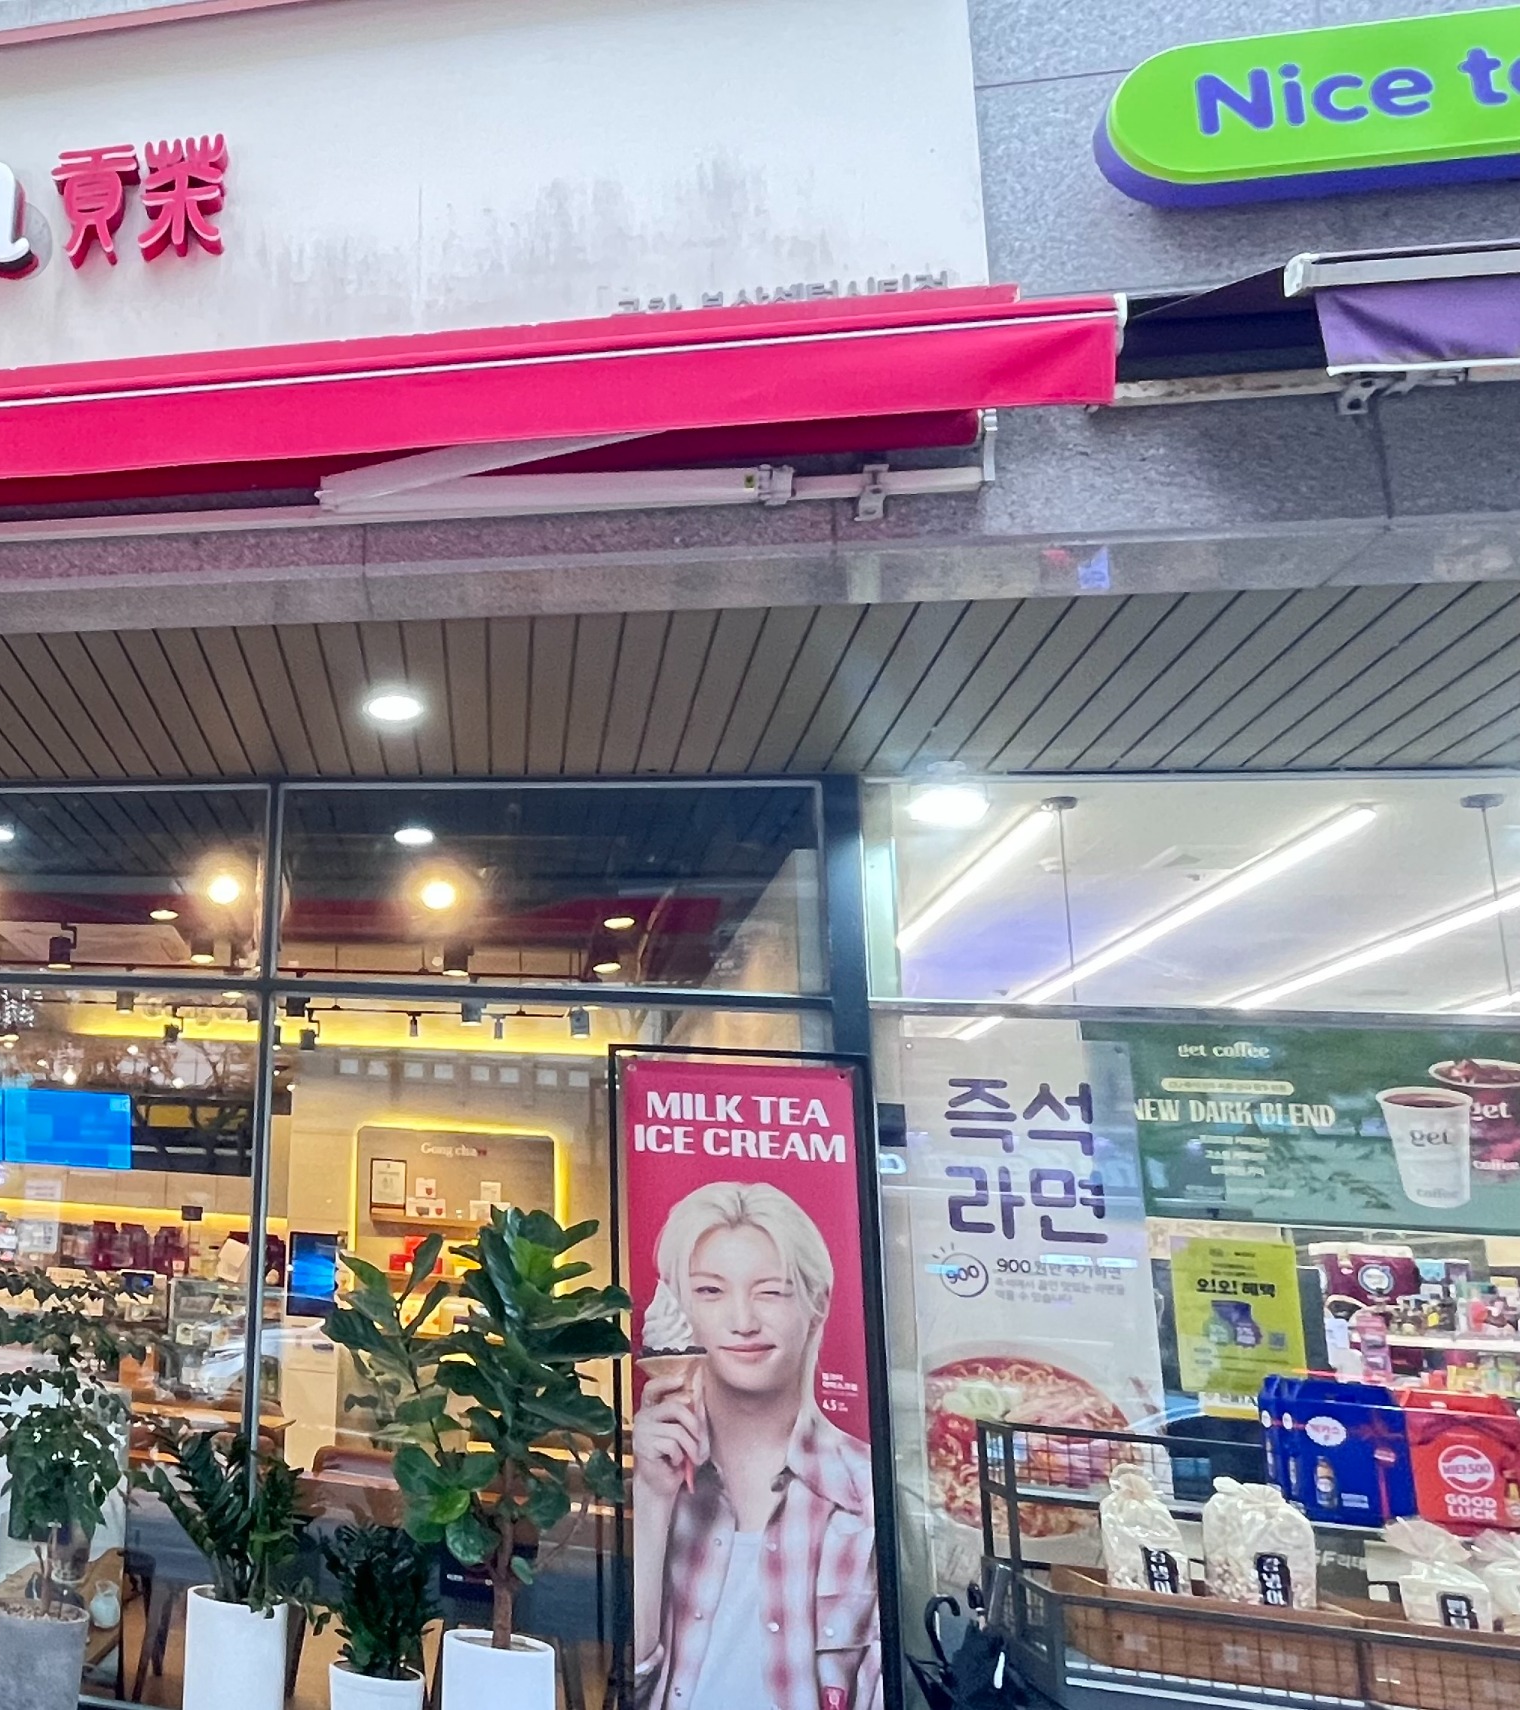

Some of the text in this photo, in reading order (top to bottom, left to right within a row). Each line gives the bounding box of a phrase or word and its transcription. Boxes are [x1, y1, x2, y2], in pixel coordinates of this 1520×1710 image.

[1195, 48, 1520, 137] Nice t
[1178, 1041, 1270, 1059] get coffee
[646, 1090, 830, 1128] MILK TEA
[944, 1078, 1095, 1156] 즉석
[1189, 1099, 1253, 1125] DARK
[1260, 1102, 1336, 1127] BLEND
[634, 1123, 847, 1163] ICE CREAM
[1409, 1129, 1454, 1147] get
[945, 1165, 1109, 1244] 라면
[945, 1264, 980, 1285] 900
[1444, 1493, 1497, 1508] GOOD
[1447, 1504, 1497, 1520] LUCK
